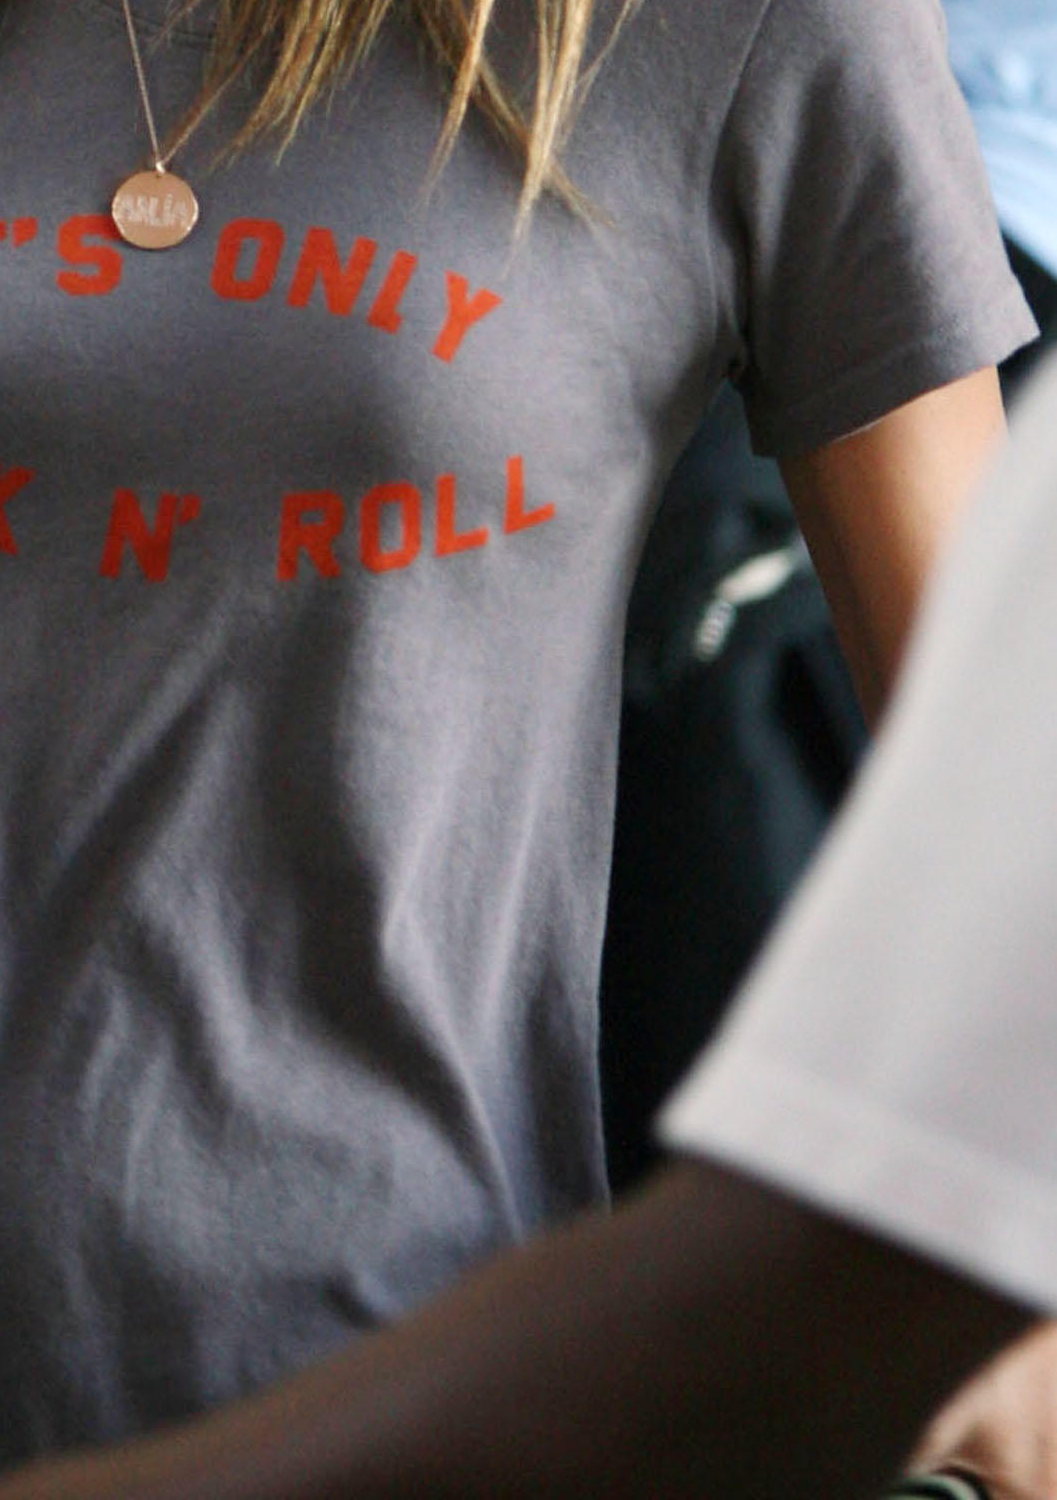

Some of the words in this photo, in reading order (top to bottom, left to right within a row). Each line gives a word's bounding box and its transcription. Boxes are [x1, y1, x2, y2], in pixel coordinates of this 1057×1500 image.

[210, 217, 501, 362] ONLY
[100, 490, 202, 581] N'
[276, 456, 557, 583] ROLL
